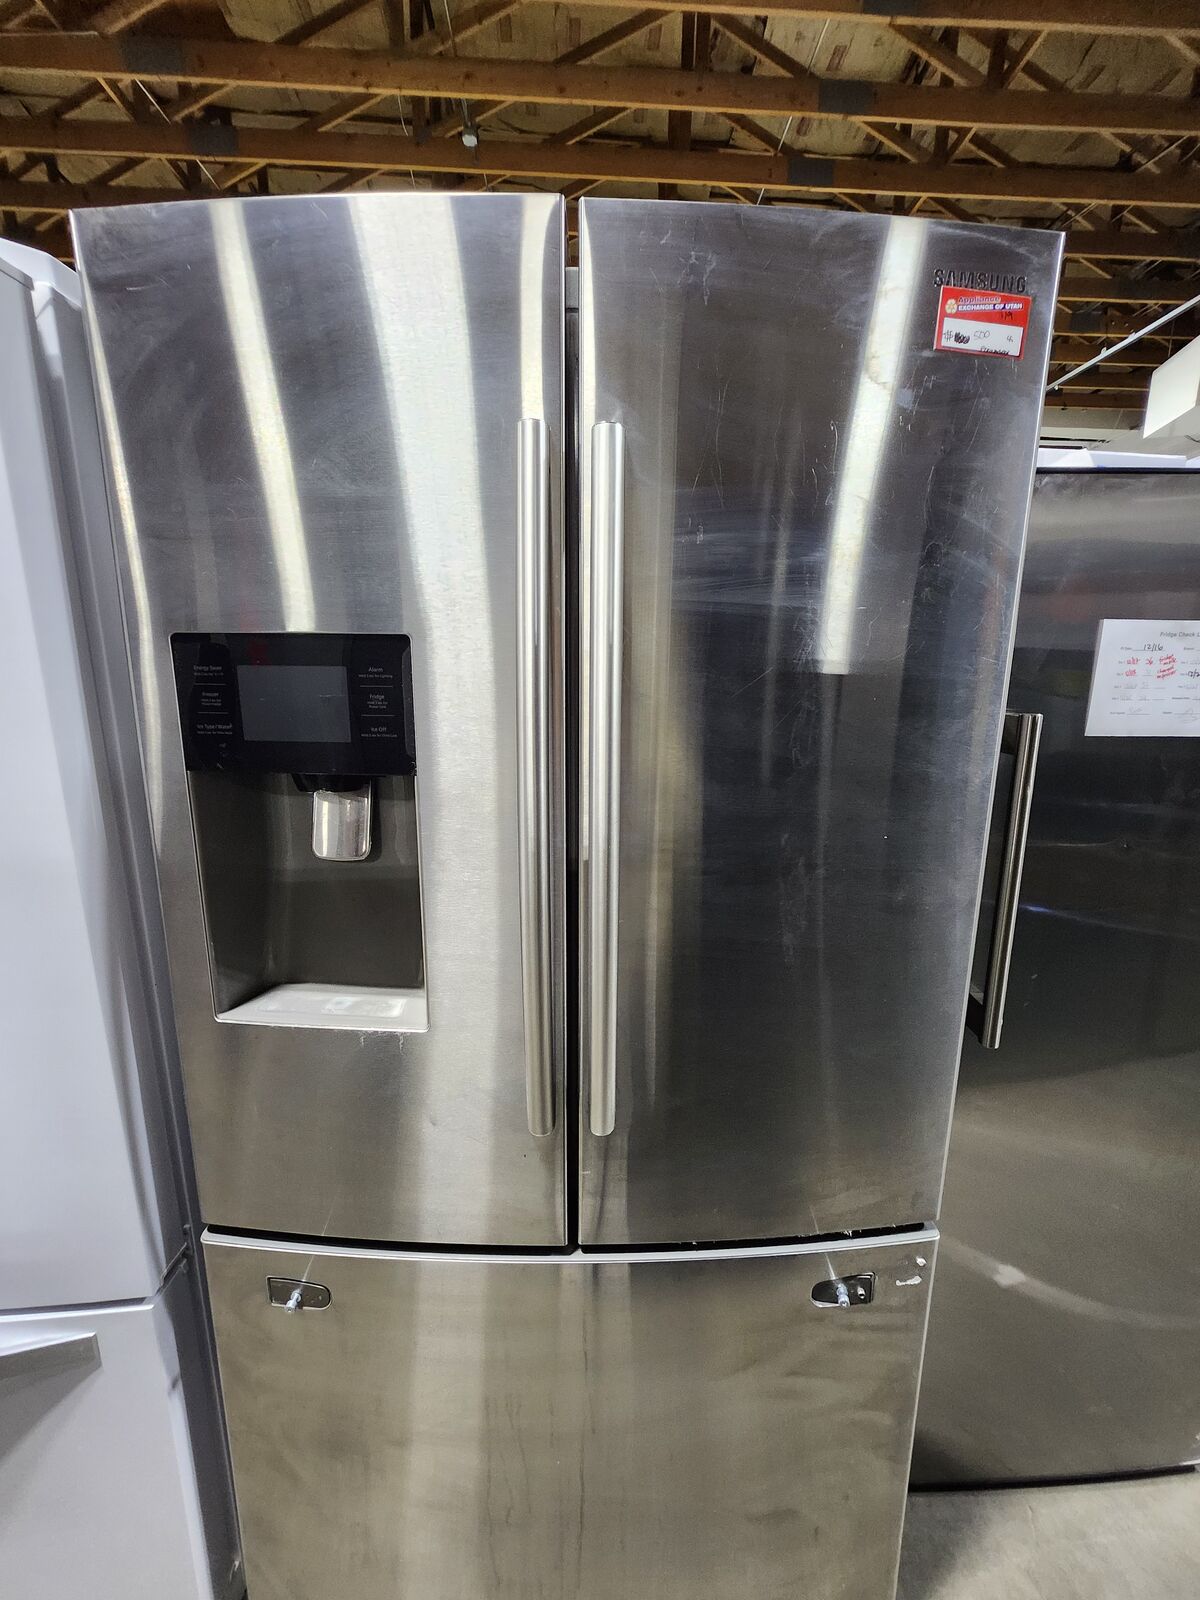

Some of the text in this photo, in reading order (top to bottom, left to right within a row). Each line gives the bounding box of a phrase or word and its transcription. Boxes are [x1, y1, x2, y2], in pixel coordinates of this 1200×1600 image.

[933, 268, 1028, 293] SAMSUNG
[958, 303, 994, 312] EXCHANGE
[1143, 643, 1163, 652] 12/16
